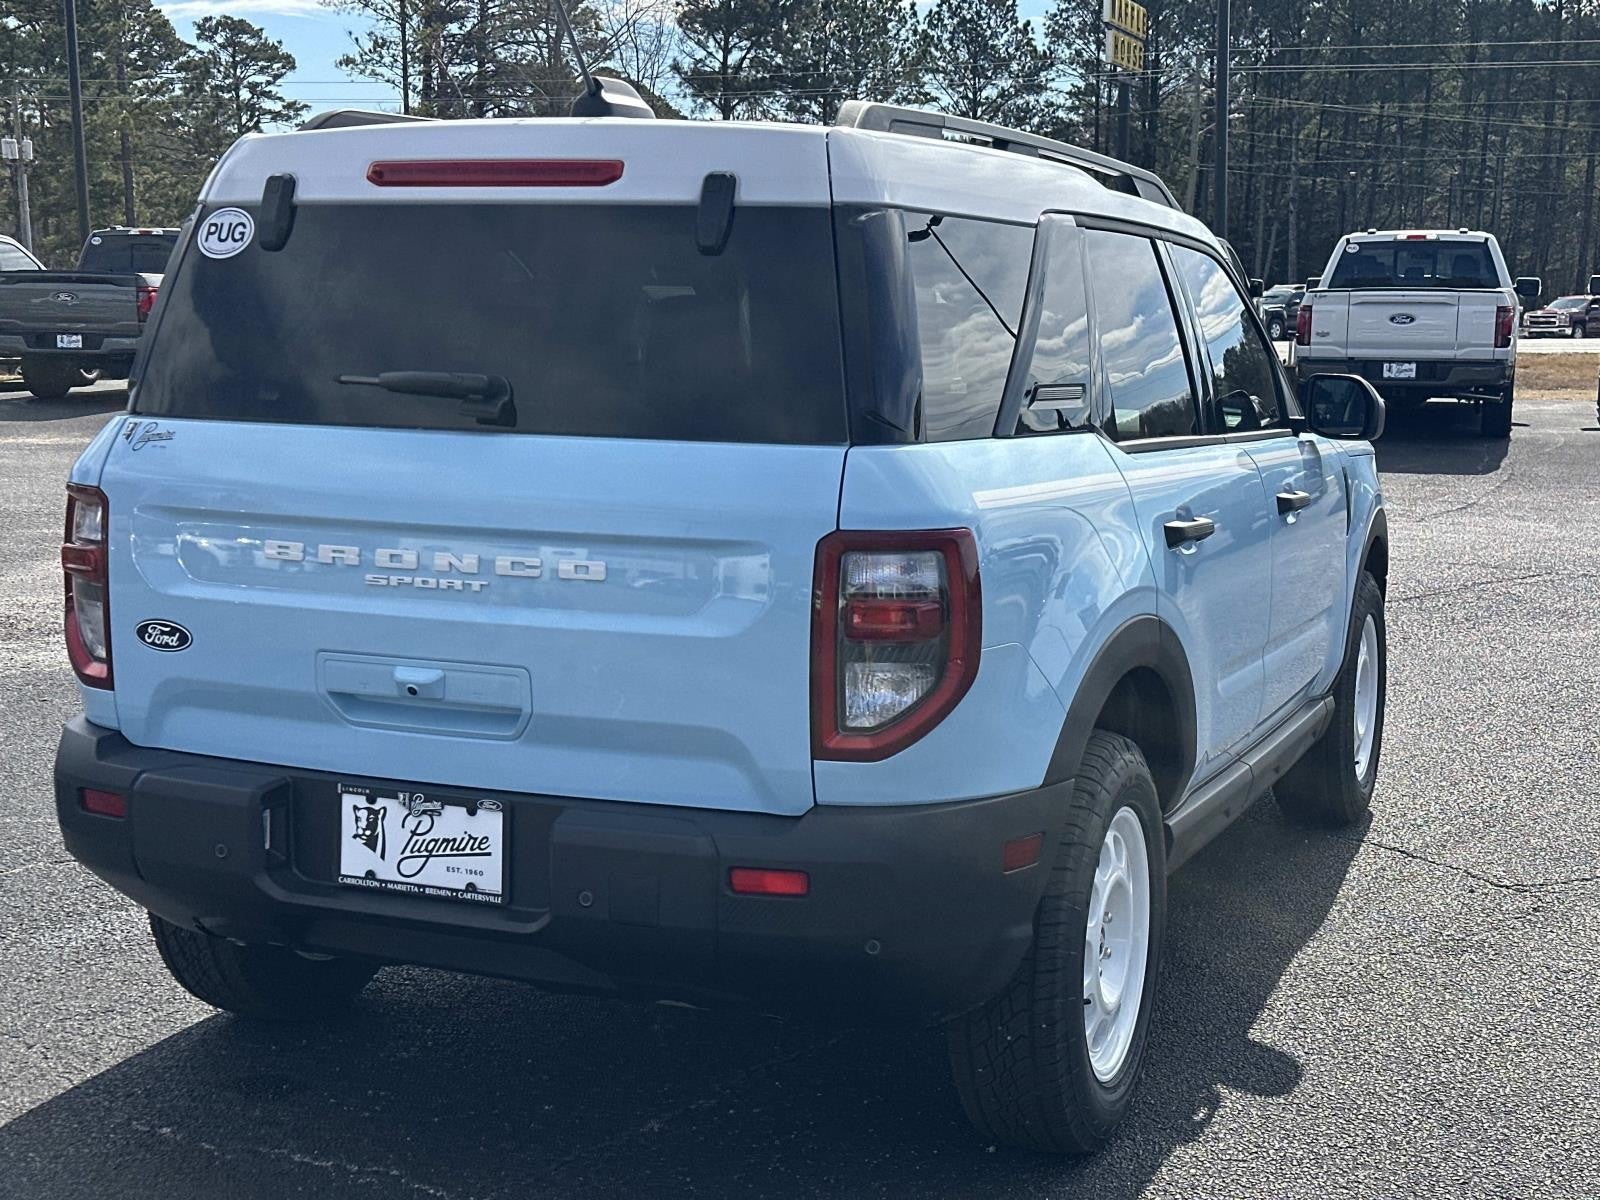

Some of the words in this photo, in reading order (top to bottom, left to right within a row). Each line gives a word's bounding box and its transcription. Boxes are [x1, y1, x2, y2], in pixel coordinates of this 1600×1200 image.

[1114, 35, 1142, 68] HOUSE
[204, 221, 247, 243] PUG
[264, 539, 607, 581] BRONCO
[365, 573, 489, 592] SPORT
[144, 624, 180, 646] Ford
[397, 812, 492, 878] Pugmire
[446, 865, 463, 874] EST.
[465, 868, 484, 877] 1960
[338, 876, 380, 888] CARROLLTON
[386, 882, 419, 893] MARIETTA
[425, 887, 451, 897] BREMEN
[457, 891, 502, 904] CARTERSVILLE
